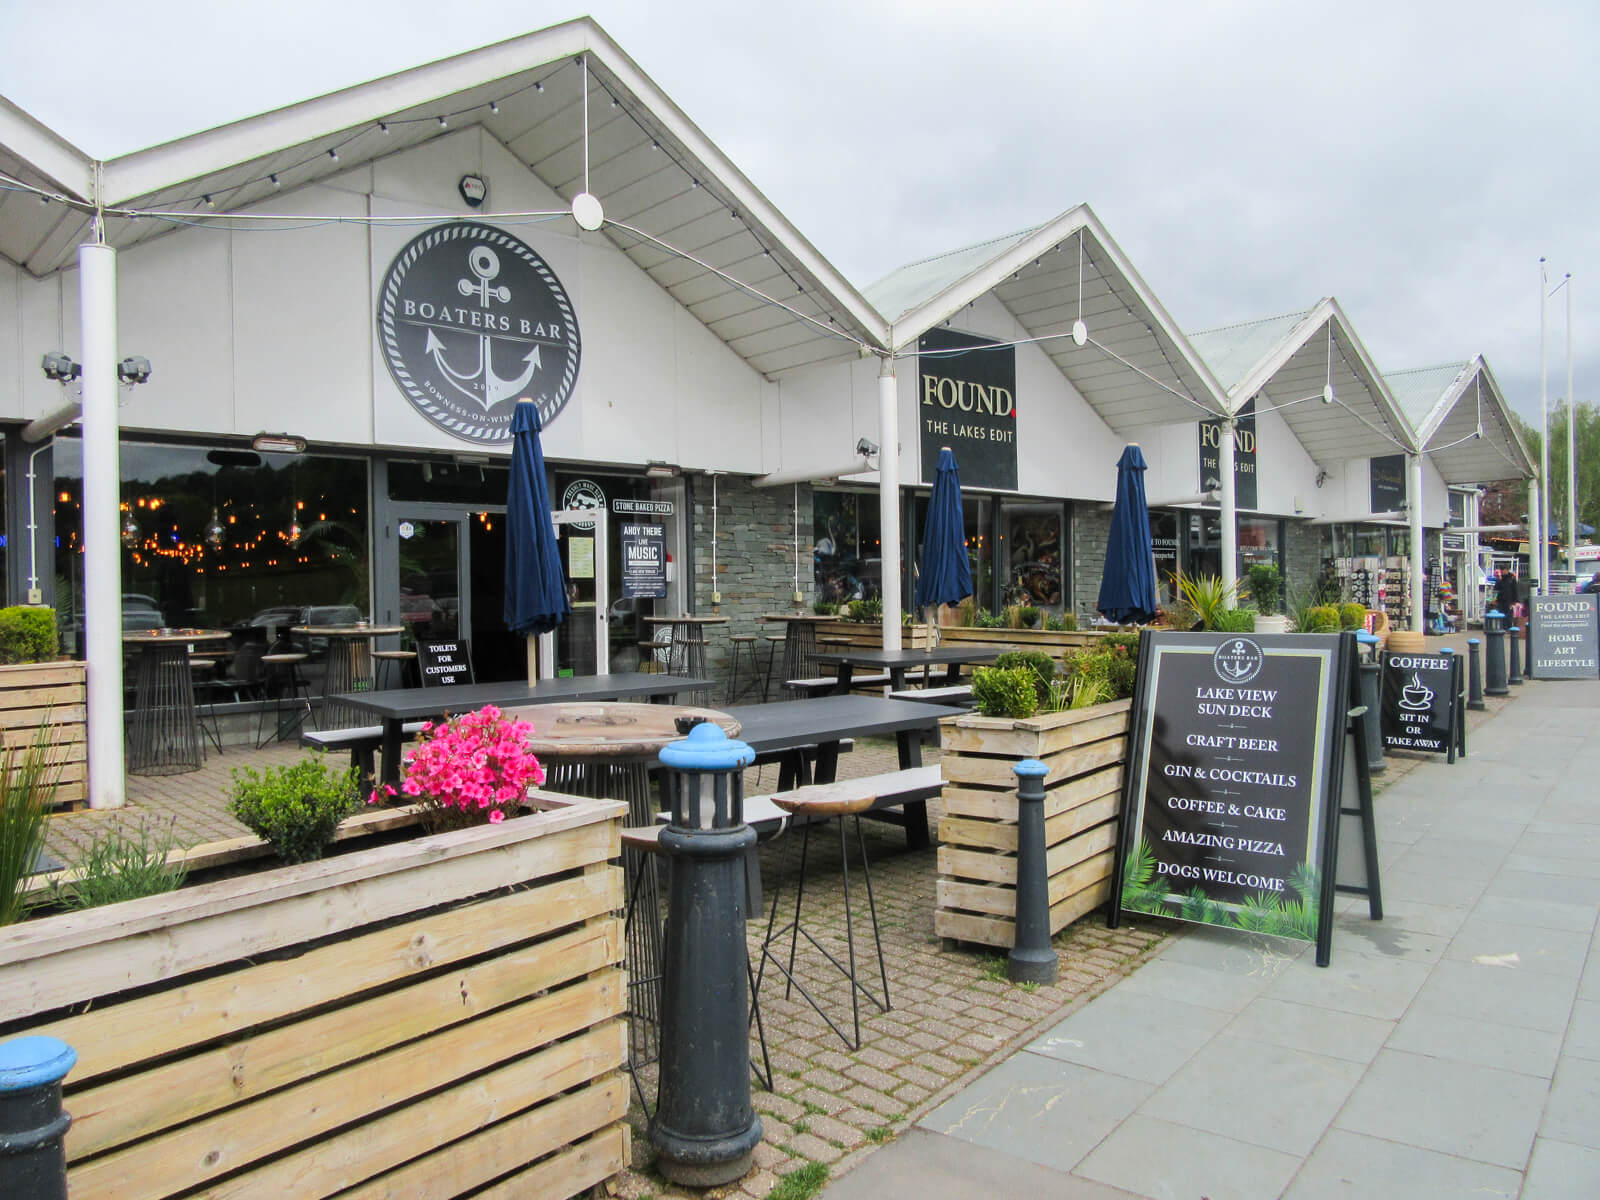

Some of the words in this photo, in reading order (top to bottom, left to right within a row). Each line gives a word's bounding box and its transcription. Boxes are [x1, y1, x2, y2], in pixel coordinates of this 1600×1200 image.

[404, 299, 510, 331] BOATERS
[520, 319, 561, 339] BAR
[927, 420, 948, 434] THE
[953, 424, 985, 439] LAKES
[990, 429, 1013, 443] EDIT
[1203, 457, 1216, 469] THE
[1240, 462, 1254, 473] EDIT
[615, 501, 634, 511] STONE
[635, 502, 654, 512] BAKED
[655, 503, 671, 513] PIZZA
[623, 526, 641, 536] AHOY
[643, 526, 663, 536] THERE
[628, 546, 658, 560] MUSIC
[1548, 633, 1584, 643] HOME
[429, 644, 458, 653] TOILETS
[1553, 646, 1577, 655] ART
[437, 655, 453, 663] FOR
[1389, 656, 1449, 671] COFFEE
[1537, 658, 1596, 668] LIFESTYLE
[425, 664, 467, 674] CUSTOMERS
[441, 676, 456, 684] USE
[1196, 687, 1235, 700] LAKE
[1237, 689, 1278, 703] VIEW
[1197, 703, 1227, 716] SUN
[1229, 704, 1273, 719] DECK
[1399, 713, 1417, 722] SIT
[1418, 714, 1430, 724] IN
[1405, 726, 1422, 735] OR
[1186, 734, 1237, 749] CRAFT
[1239, 738, 1279, 753] BEER
[1386, 736, 1413, 746] TAKE
[1413, 738, 1441, 749] AWAY
[1164, 764, 1193, 778] GIN
[1194, 767, 1207, 779] &
[1209, 768, 1297, 787] COCKTAILS
[1167, 796, 1226, 815] COFFEE
[1227, 803, 1242, 817] &
[1243, 805, 1287, 822] CAKE
[1162, 829, 1235, 850] AMAZING
[1237, 838, 1286, 857] PIZZA
[1157, 861, 1201, 879] DOGS
[1202, 867, 1286, 893] WELCOME
